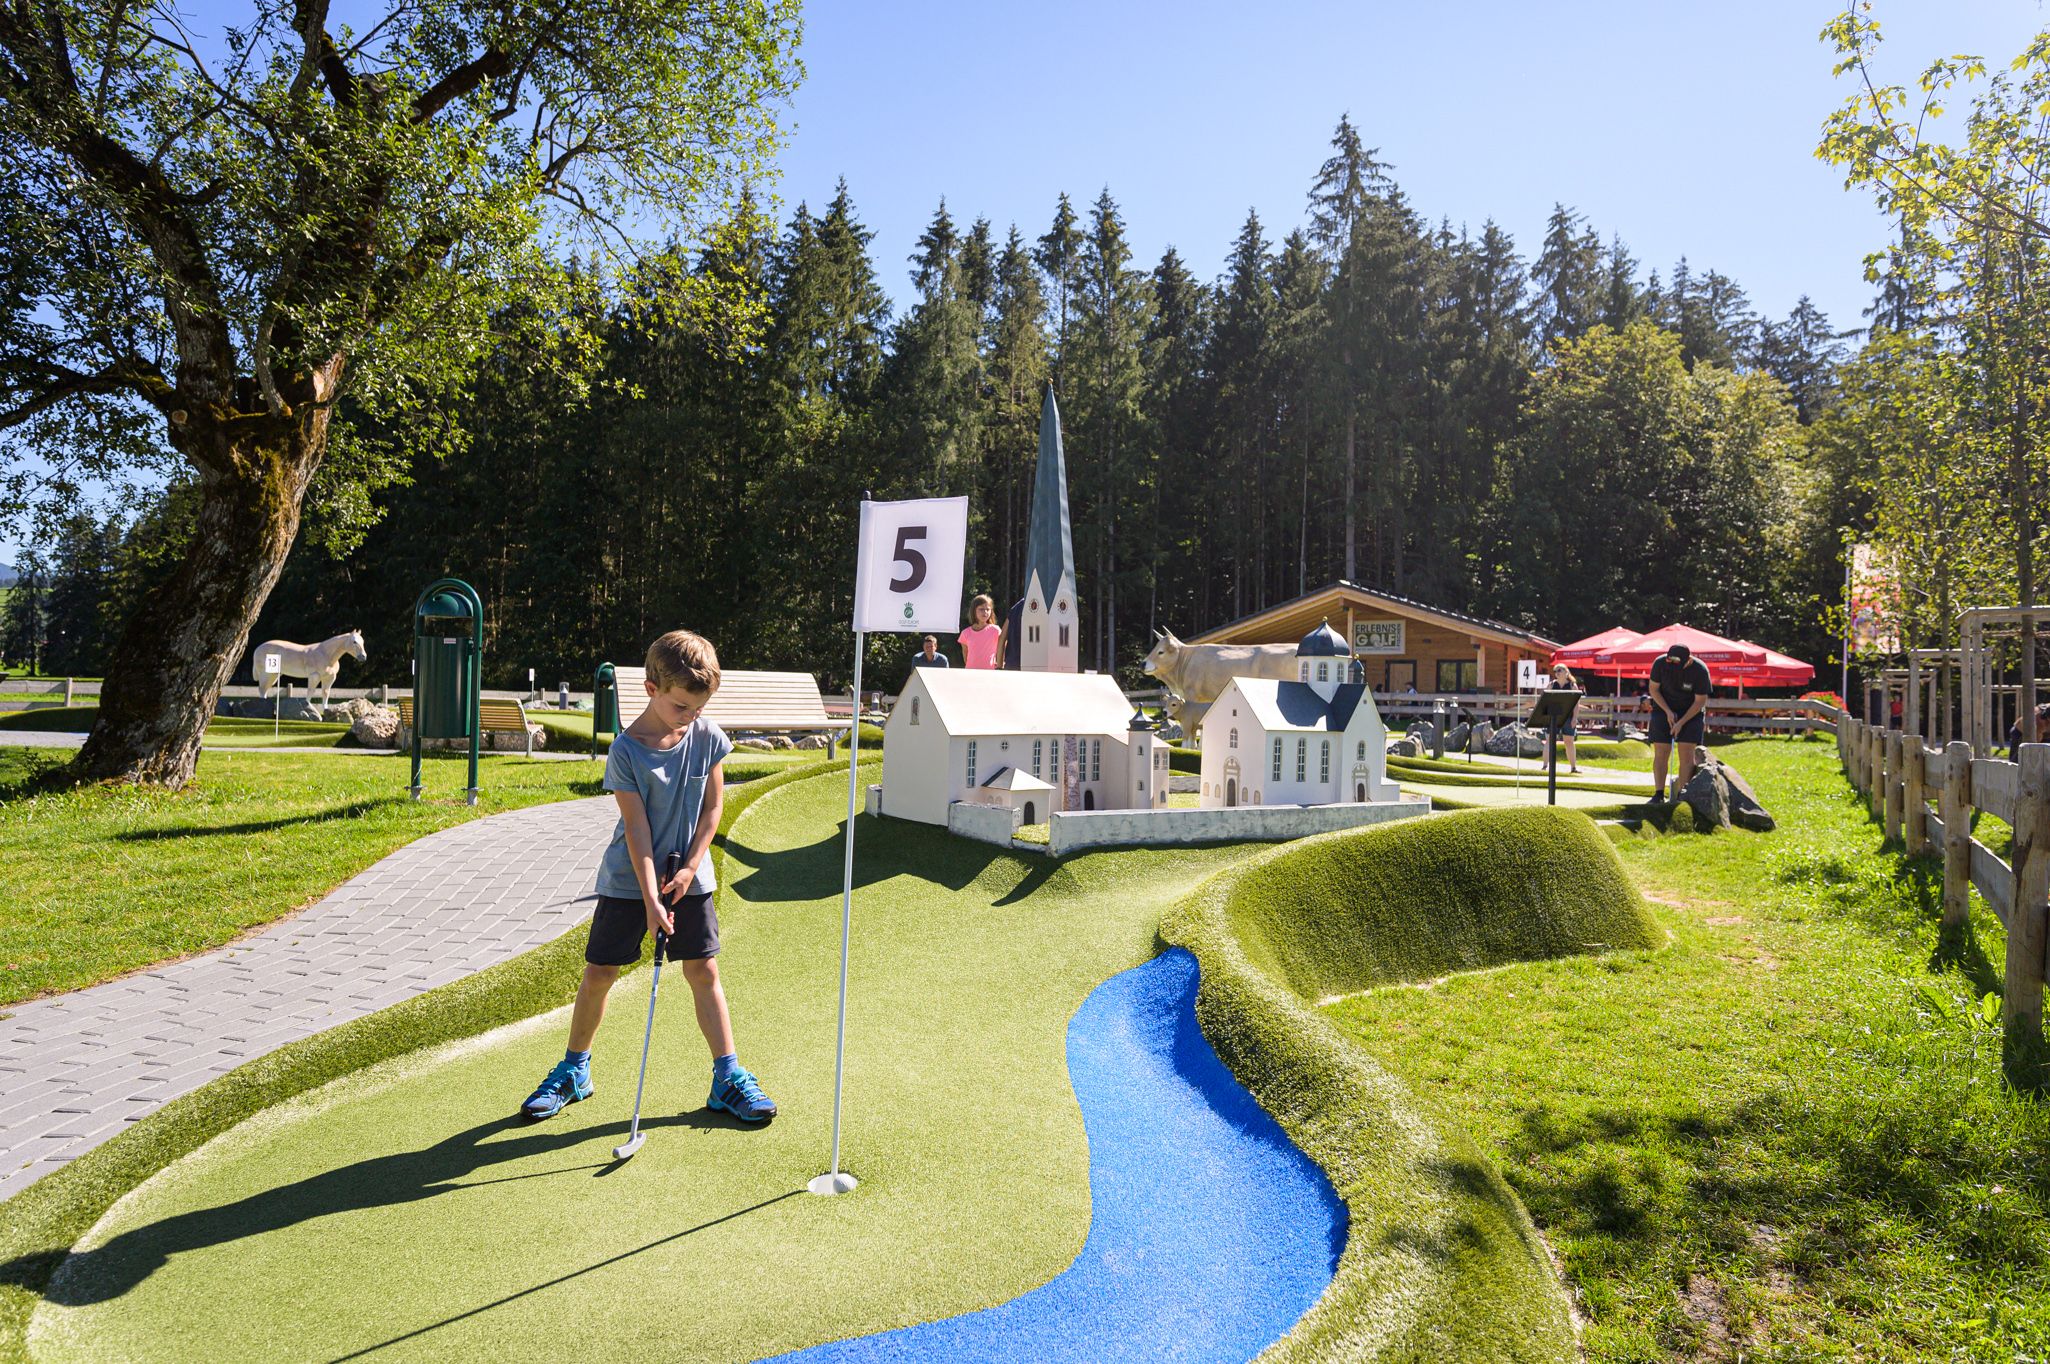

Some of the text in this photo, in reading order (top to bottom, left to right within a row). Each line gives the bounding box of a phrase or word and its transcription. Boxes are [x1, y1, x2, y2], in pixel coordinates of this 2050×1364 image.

[889, 526, 927, 593] 5
[1356, 624, 1397, 633] ERLEBNIS
[1356, 633, 1395, 646] GOLF
[267, 658, 277, 668] 13
[1523, 666, 1530, 680] 4
